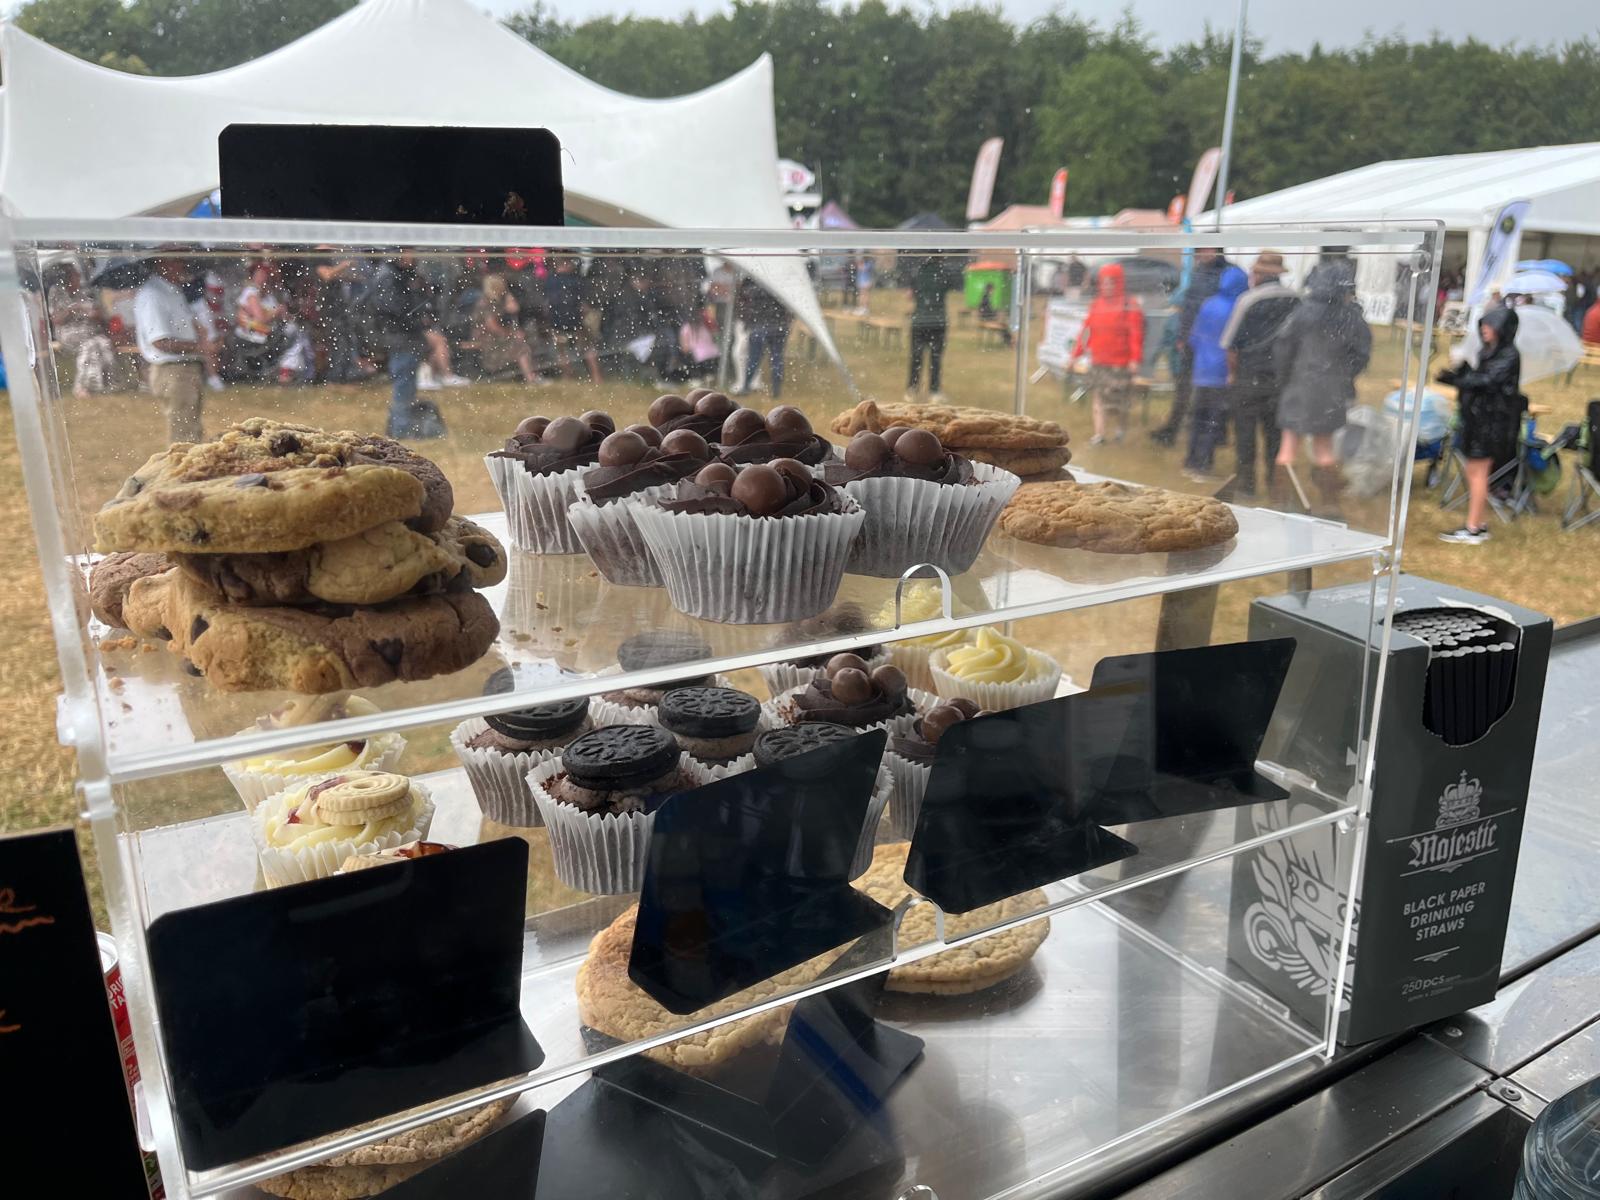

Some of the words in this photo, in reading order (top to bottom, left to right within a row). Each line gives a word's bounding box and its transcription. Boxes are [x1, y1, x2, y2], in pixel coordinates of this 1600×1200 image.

[1408, 818, 1498, 868] Majestic
[1403, 893, 1447, 915] BLACK
[1449, 881, 1486, 903] PAPER
[1410, 900, 1475, 928] DRINKING
[1415, 918, 1465, 941] STRAWS
